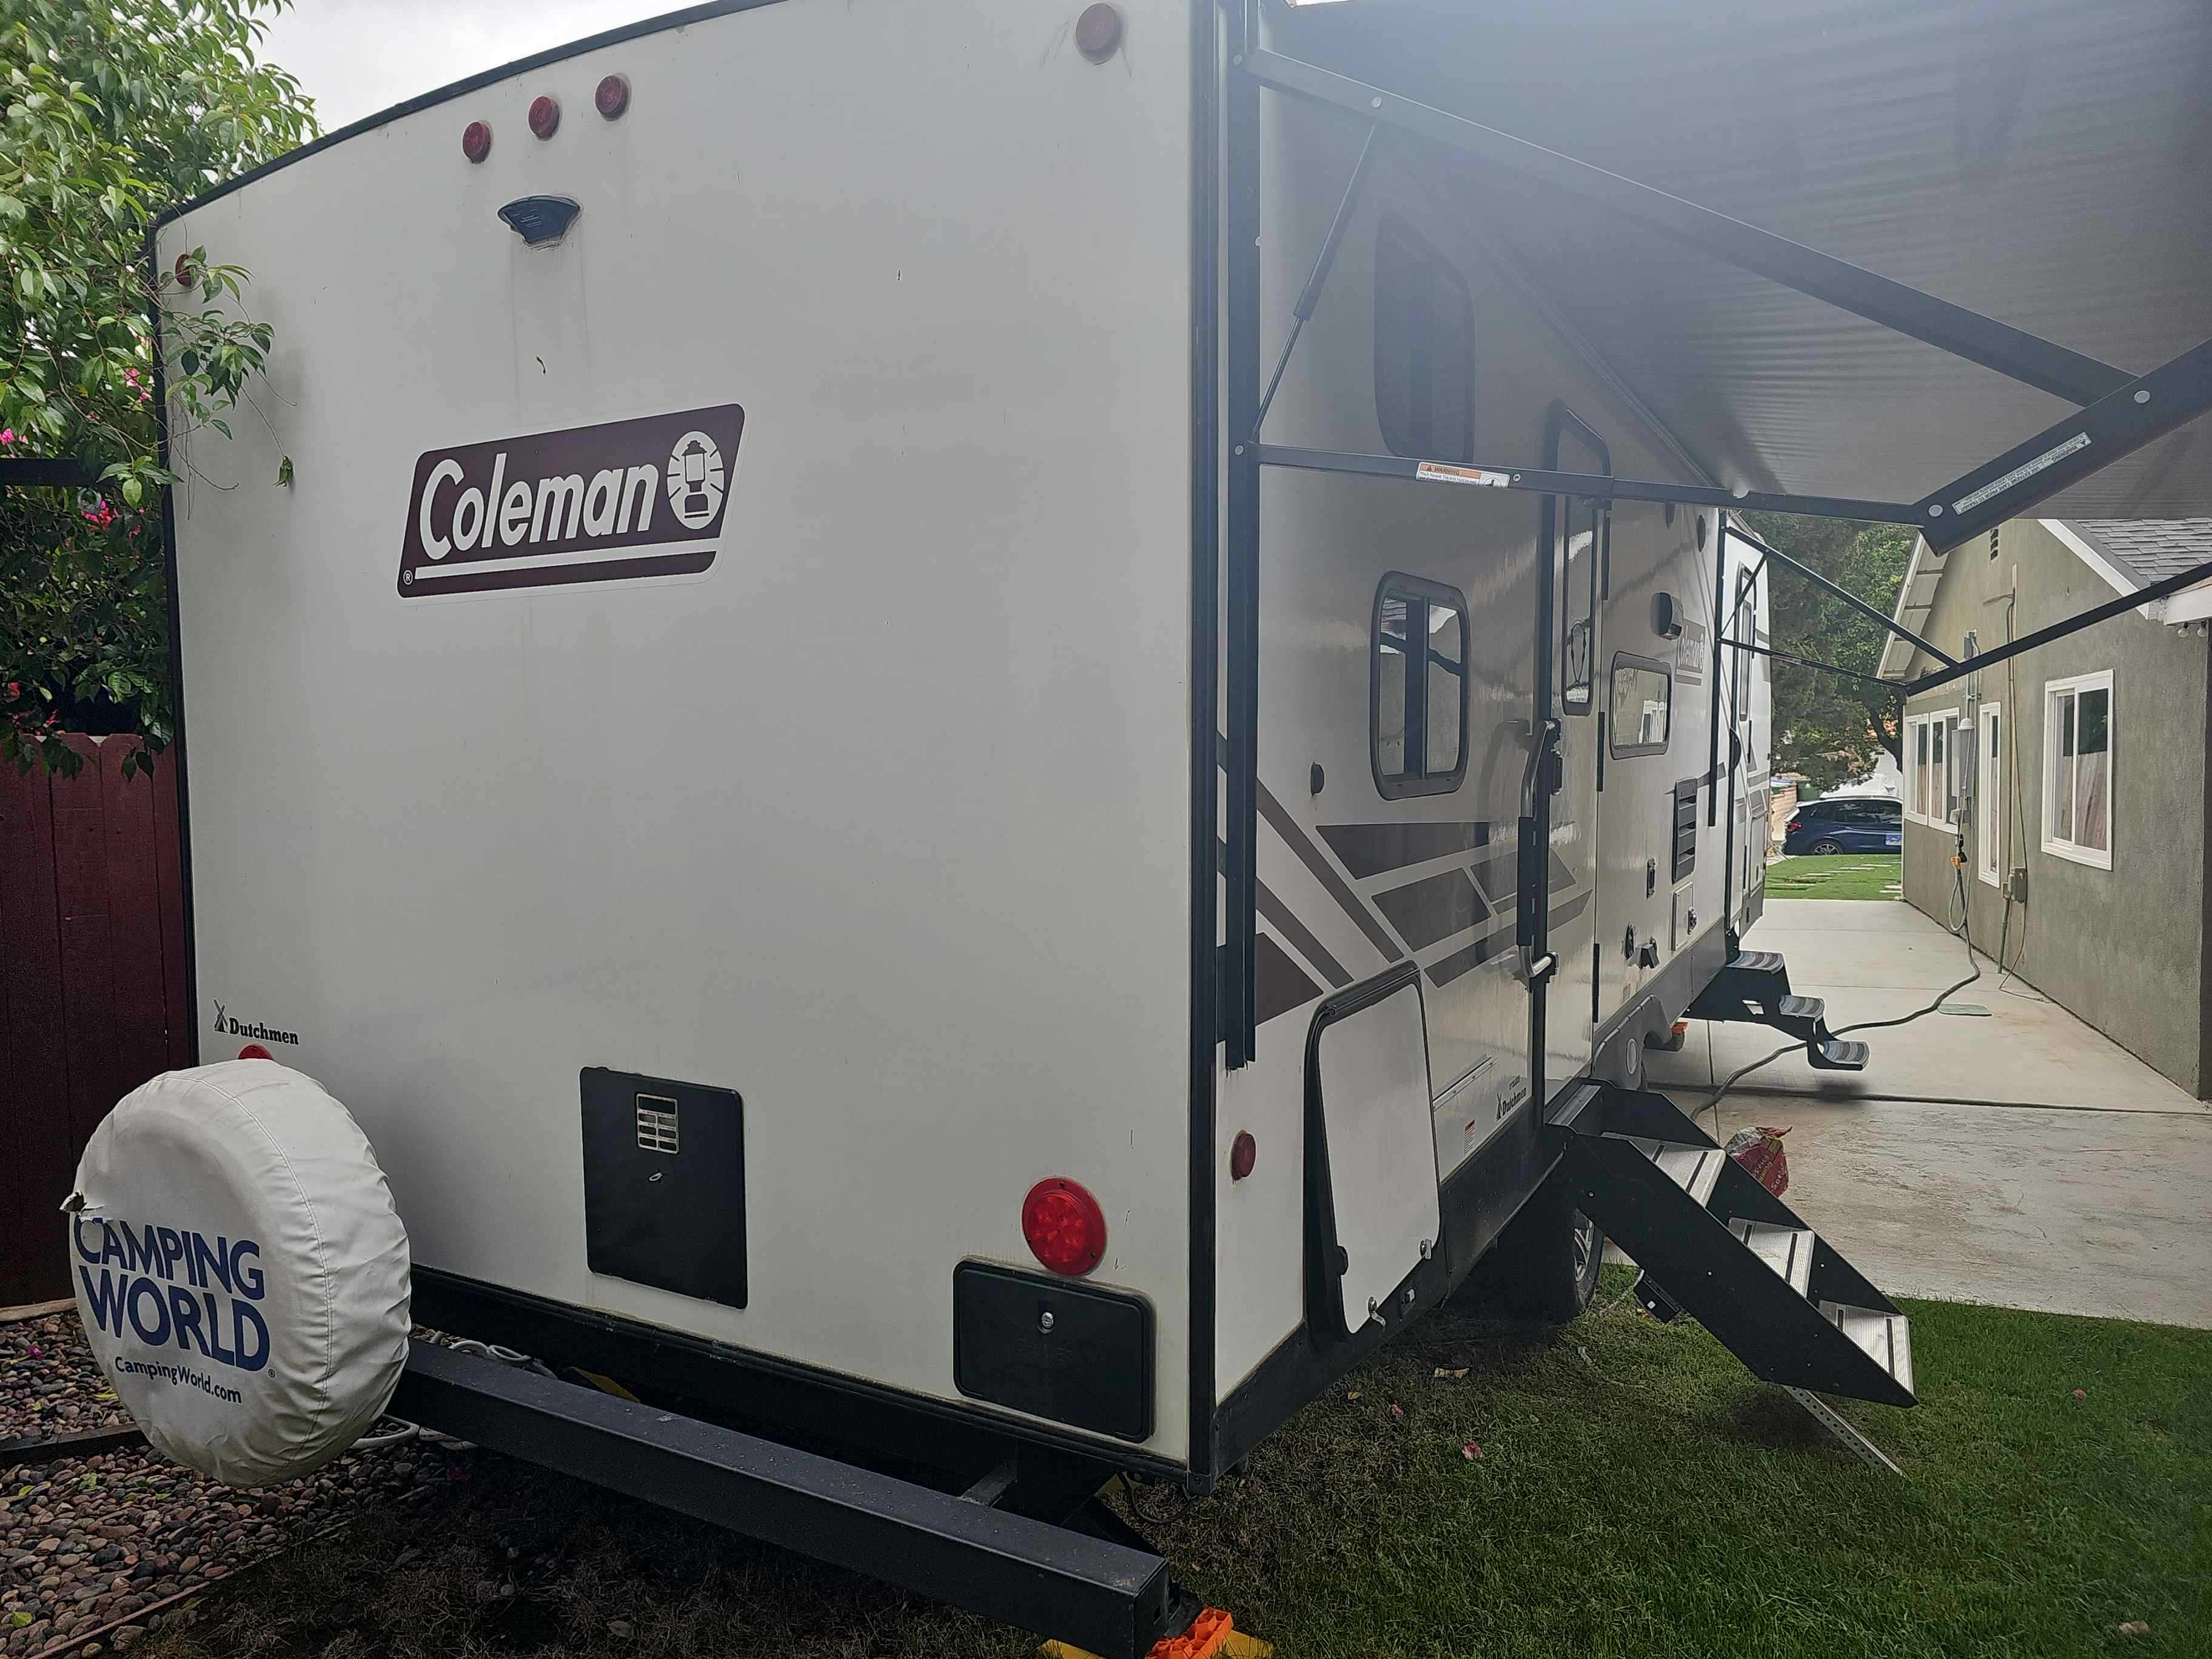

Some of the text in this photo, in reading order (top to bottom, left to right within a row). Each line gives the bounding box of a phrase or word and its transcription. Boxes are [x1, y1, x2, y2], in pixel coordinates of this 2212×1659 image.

[1434, 466, 1460, 476] WARNING
[420, 452, 659, 560] Coleman
[229, 1017, 299, 1045] Dutchmen
[1503, 1087, 1527, 1116] Dutchmen
[73, 1213, 266, 1301] CAMPING
[78, 1265, 270, 1372] WORLD
[115, 1356, 242, 1404] CampingWorld.com
